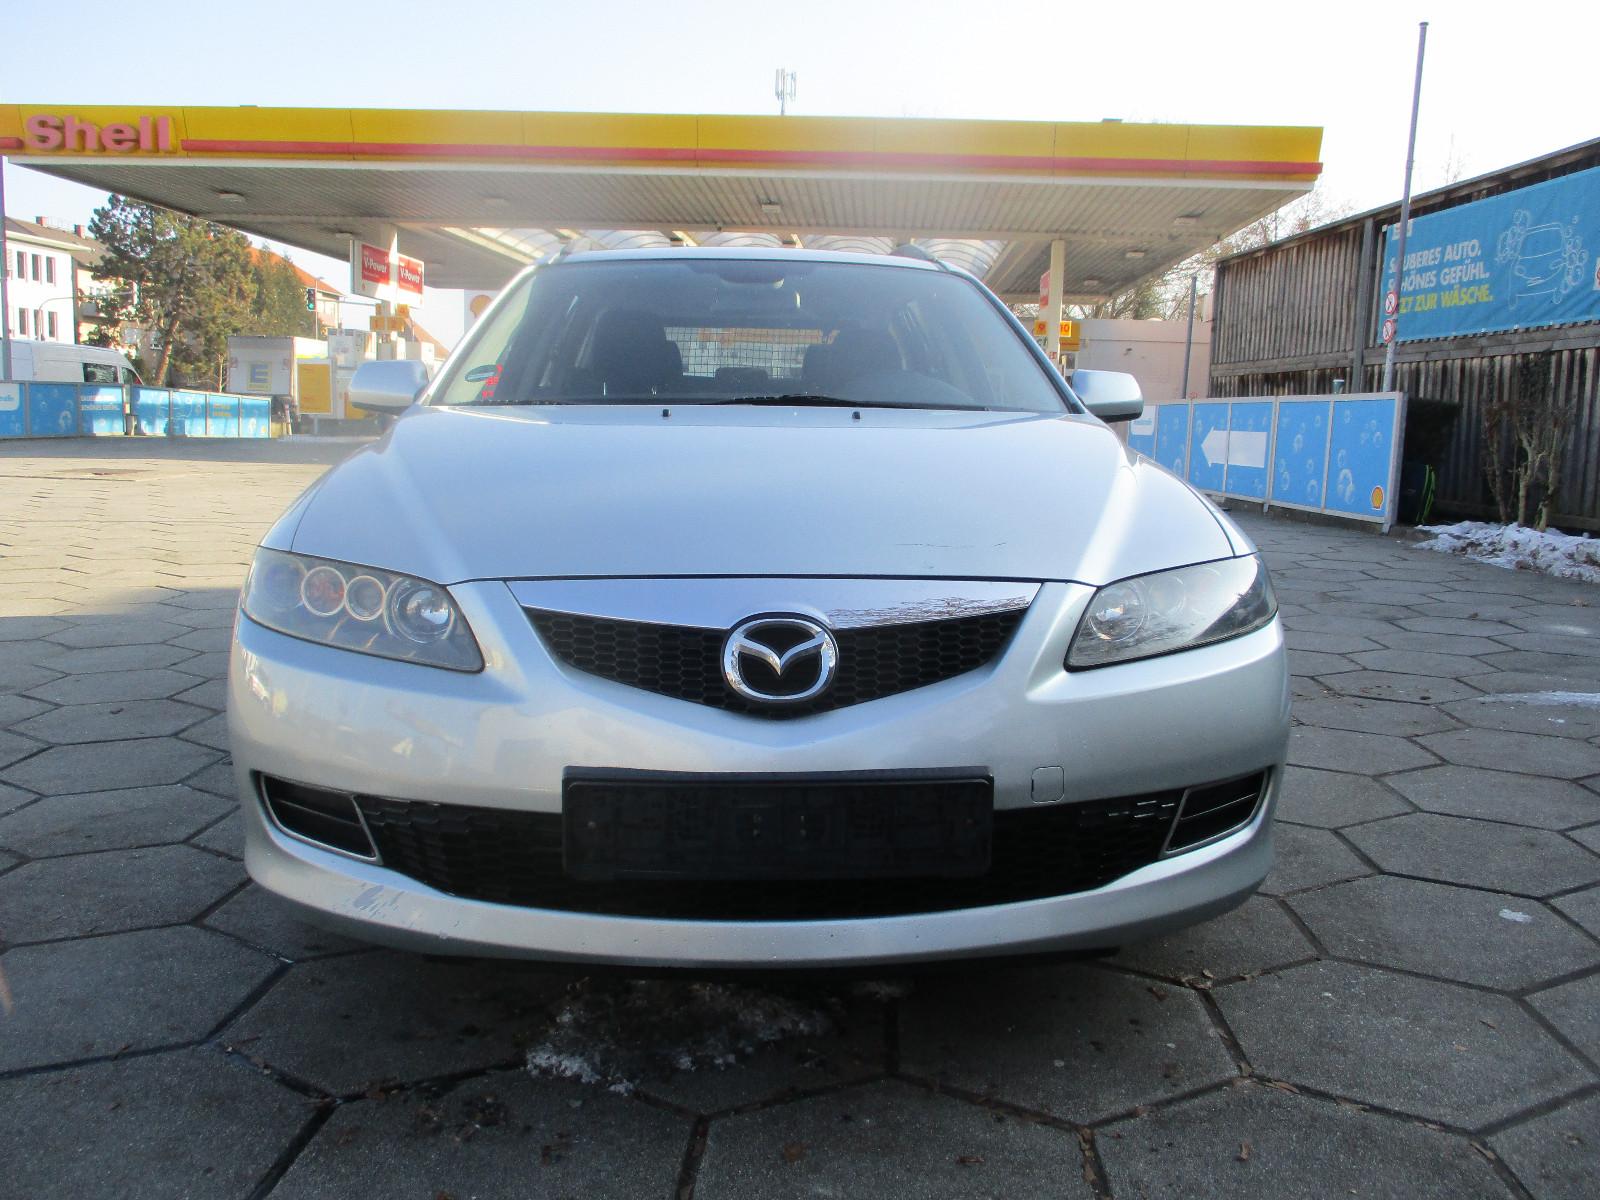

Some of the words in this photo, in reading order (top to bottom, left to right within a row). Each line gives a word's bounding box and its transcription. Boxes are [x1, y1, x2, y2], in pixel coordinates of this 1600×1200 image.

[26, 114, 174, 151] Shell
[364, 257, 387, 273] V-Power
[1389, 247, 1442, 273] SUBERES
[400, 266, 420, 284] V-Power
[1388, 270, 1438, 292] SHÖNES
[1440, 258, 1490, 286] GEFÜHL.
[1415, 292, 1438, 312] ZUR
[1441, 283, 1493, 308] WÄSCHE.
